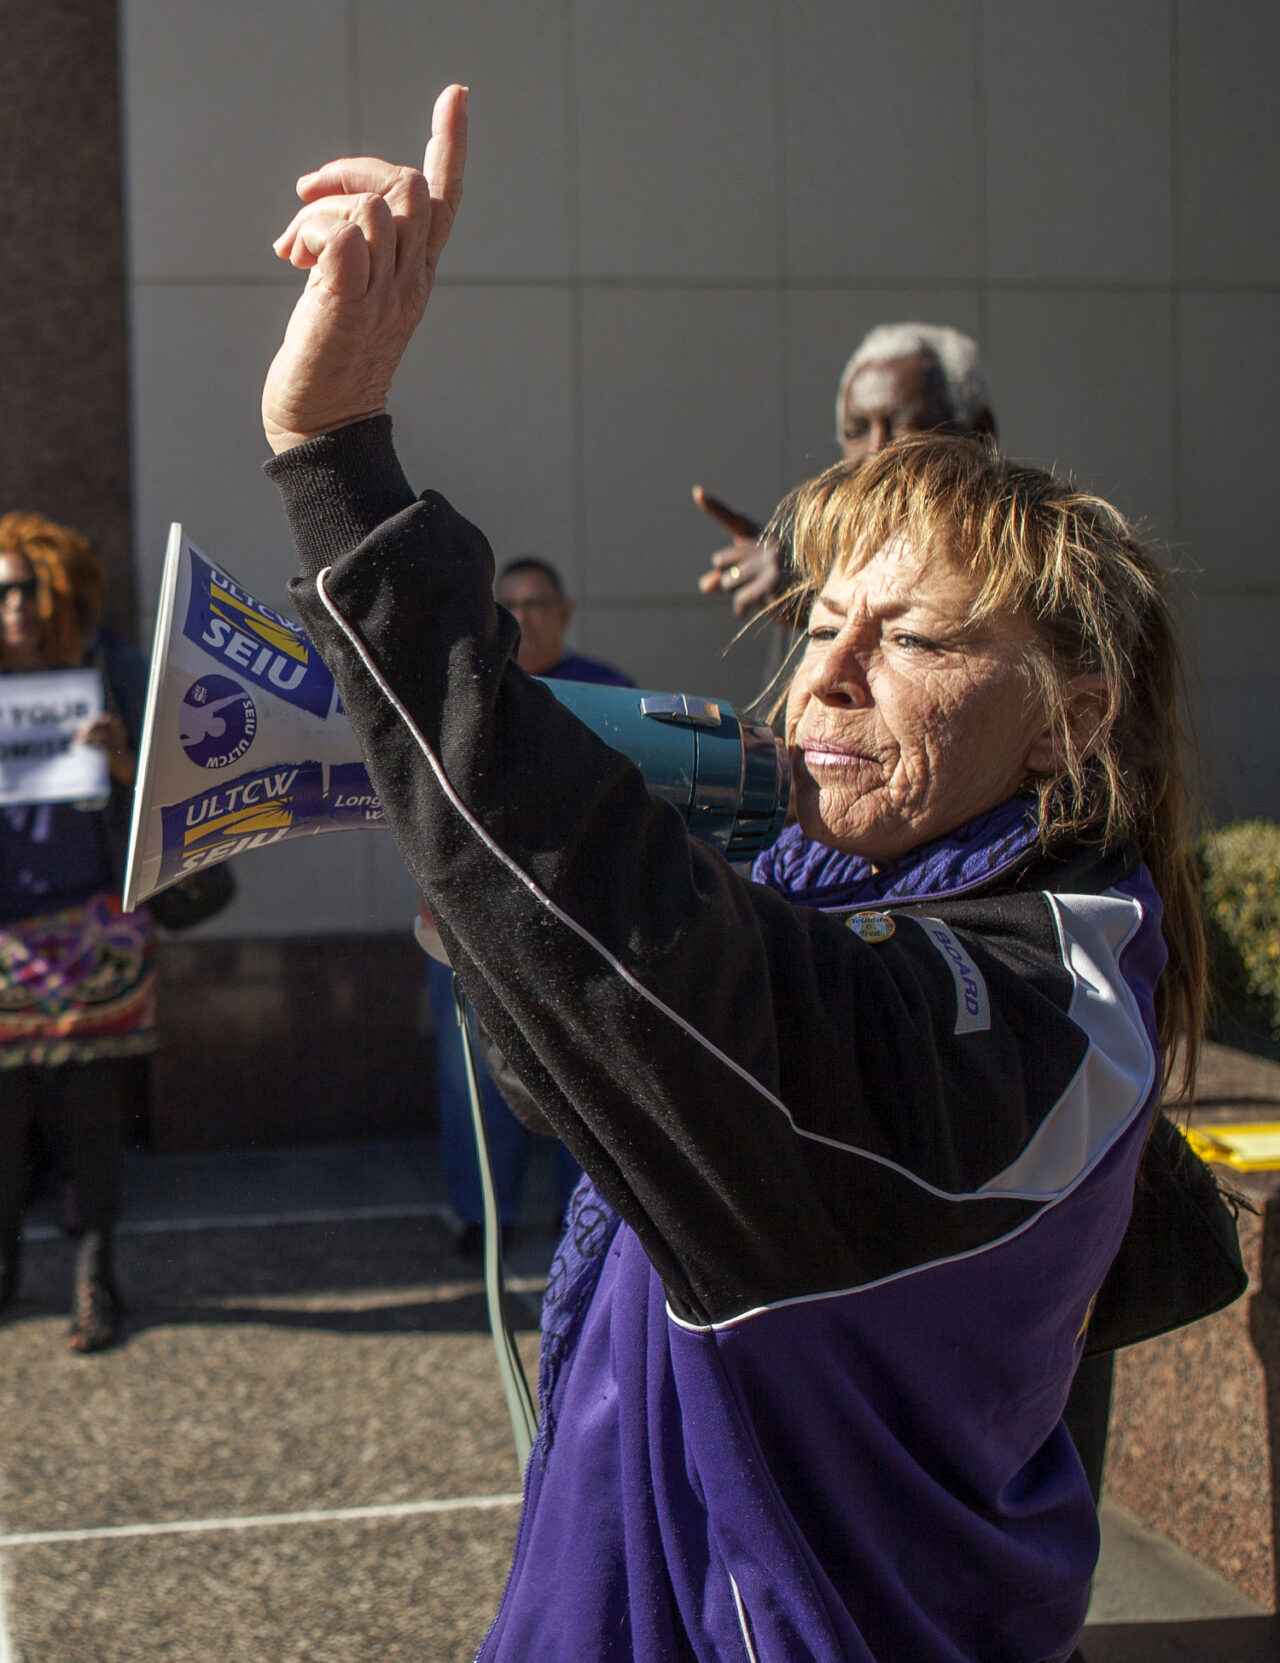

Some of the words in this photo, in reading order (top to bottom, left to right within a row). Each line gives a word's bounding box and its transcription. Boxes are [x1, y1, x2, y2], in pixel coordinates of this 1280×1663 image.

[210, 569, 305, 633] ULTCW
[202, 618, 308, 690] SEIU
[10, 700, 89, 726] YOUR
[243, 700, 255, 735] SEIU
[206, 739, 249, 768] ULTCW
[186, 769, 299, 826] ULTCW
[334, 794, 382, 808] Long
[175, 827, 290, 878] SEIU
[932, 930, 979, 1017] BOARD
